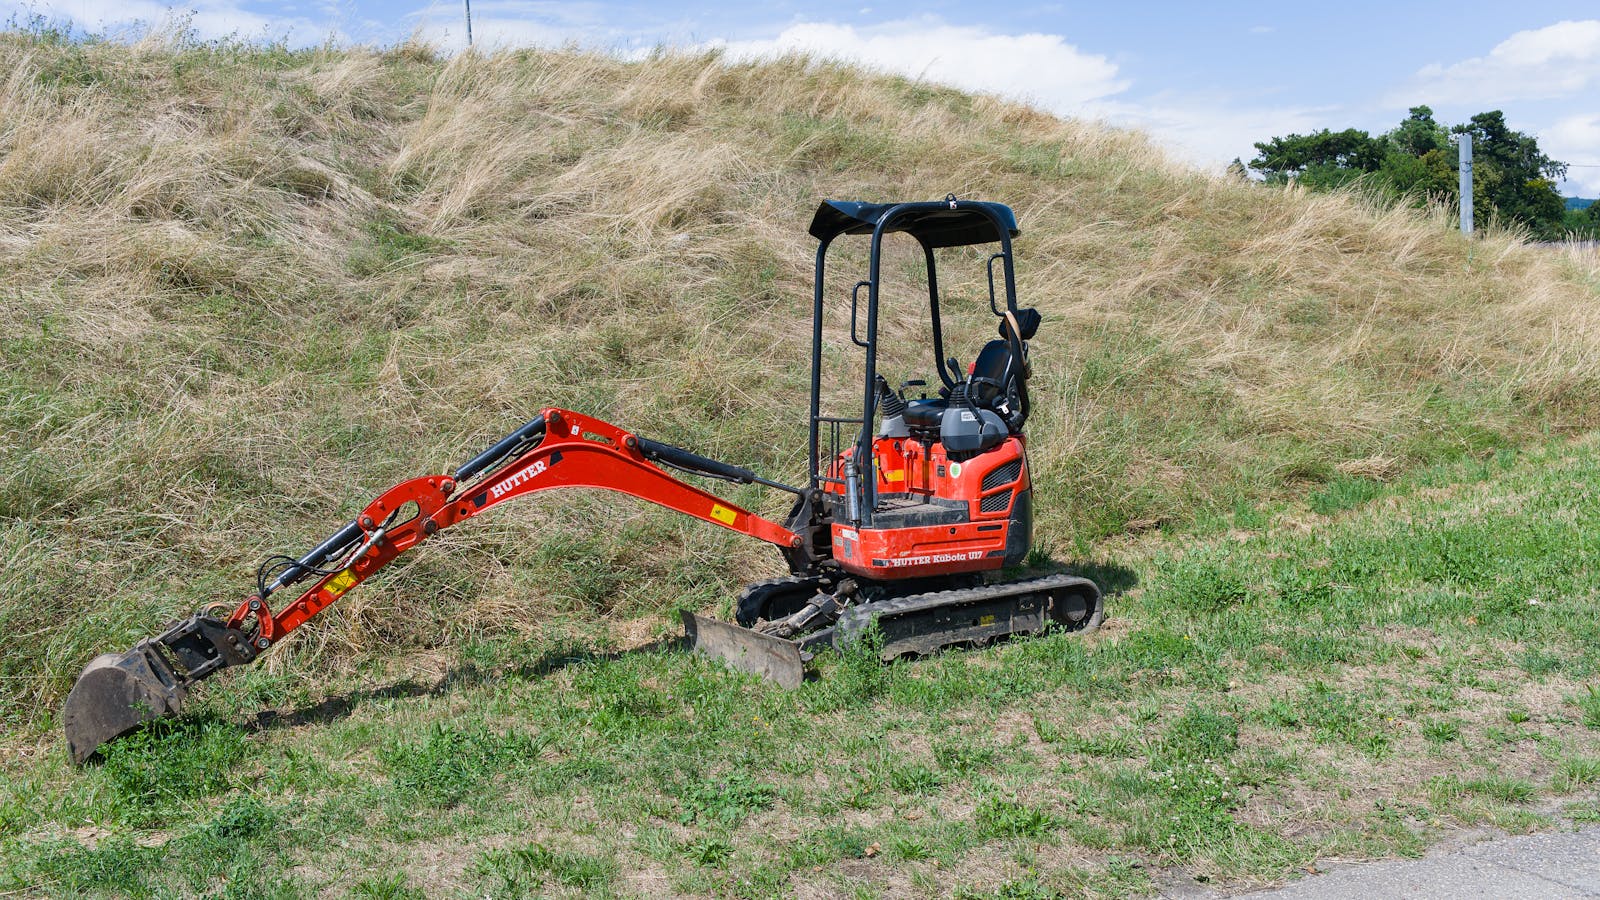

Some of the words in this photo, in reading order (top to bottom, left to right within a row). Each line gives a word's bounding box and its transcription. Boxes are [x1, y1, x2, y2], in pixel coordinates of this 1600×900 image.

[490, 460, 547, 499] HUTTER
[893, 555, 931, 567] HUTTER
[933, 553, 967, 563] Kubota
[968, 551, 983, 560] U17
